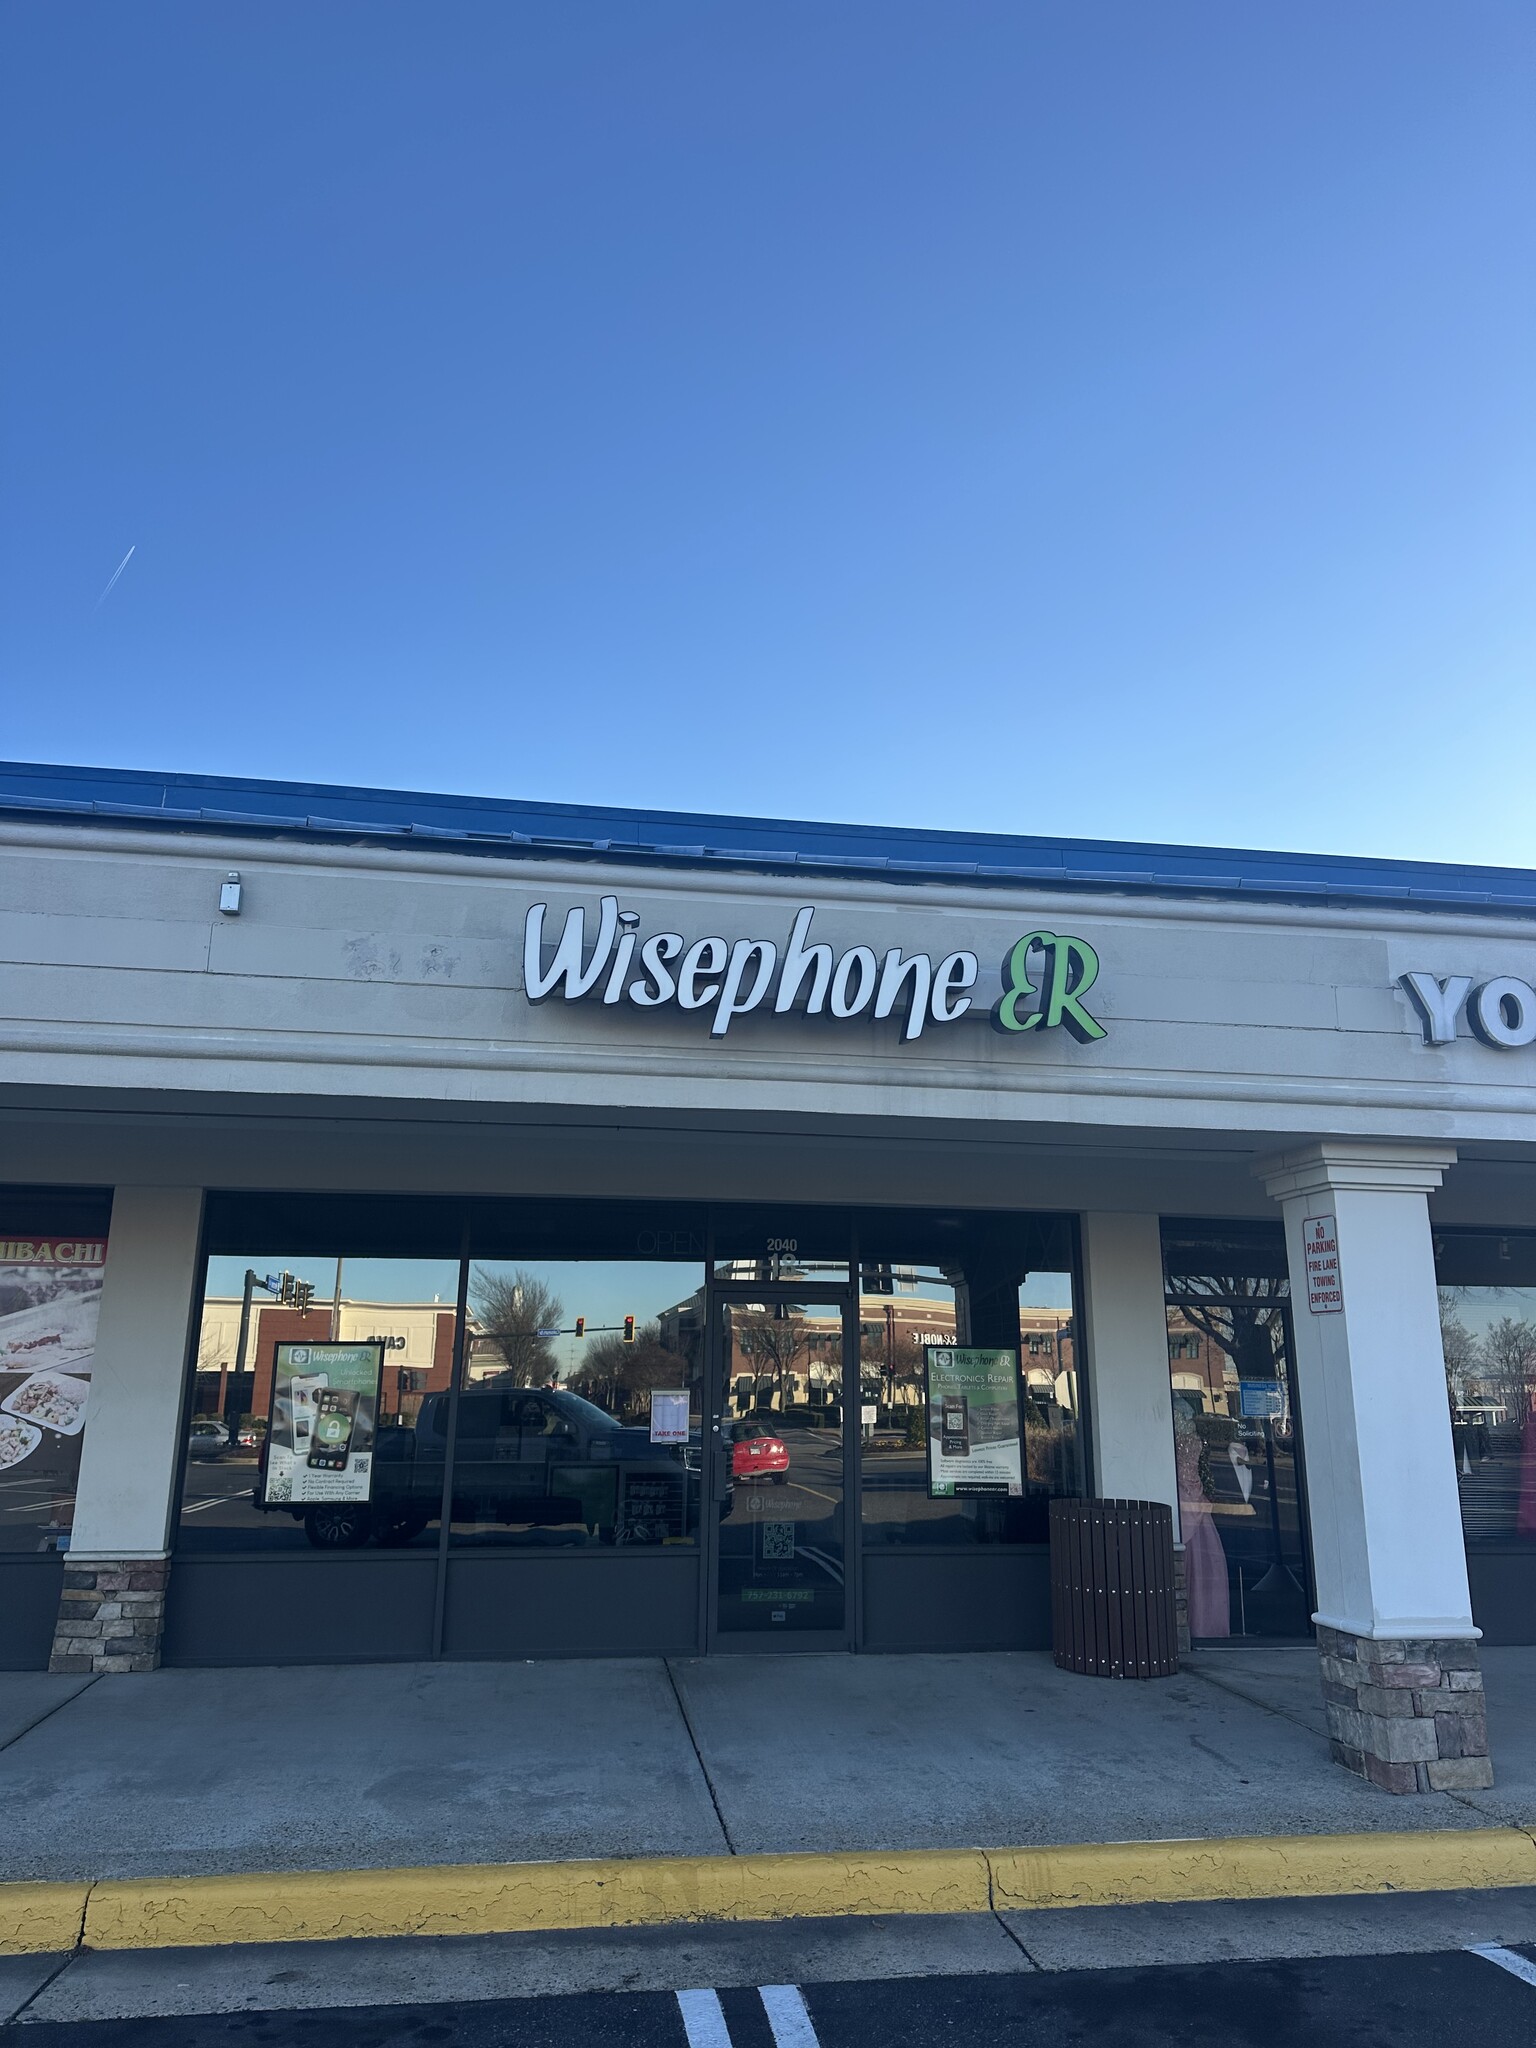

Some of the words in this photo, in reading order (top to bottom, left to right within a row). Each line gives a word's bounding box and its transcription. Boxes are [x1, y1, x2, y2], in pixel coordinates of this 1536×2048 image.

[523, 895, 980, 1043] Wisephone
[992, 930, 1107, 1043] ER
[1315, 1227, 1325, 1239] NO
[637, 1230, 705, 1254] OPEN
[767, 1238, 797, 1251] 2040
[1307, 1239, 1336, 1255] PARKING
[768, 1253, 796, 1280] 18
[1308, 1260, 1321, 1272] FIRE
[1322, 1259, 1337, 1271] LANE
[1312, 1275, 1335, 1287] TOWING
[1311, 1291, 1340, 1303] ENFORCED
[313, 1350, 358, 1364] Wisephone
[1000, 1355, 1010, 1367] ER
[340, 1368, 373, 1376] Unlocked
[931, 1372, 985, 1382] ELECTRONICS
[987, 1374, 1014, 1383] REPAIR
[747, 1591, 809, 1600] 757-231-6792
